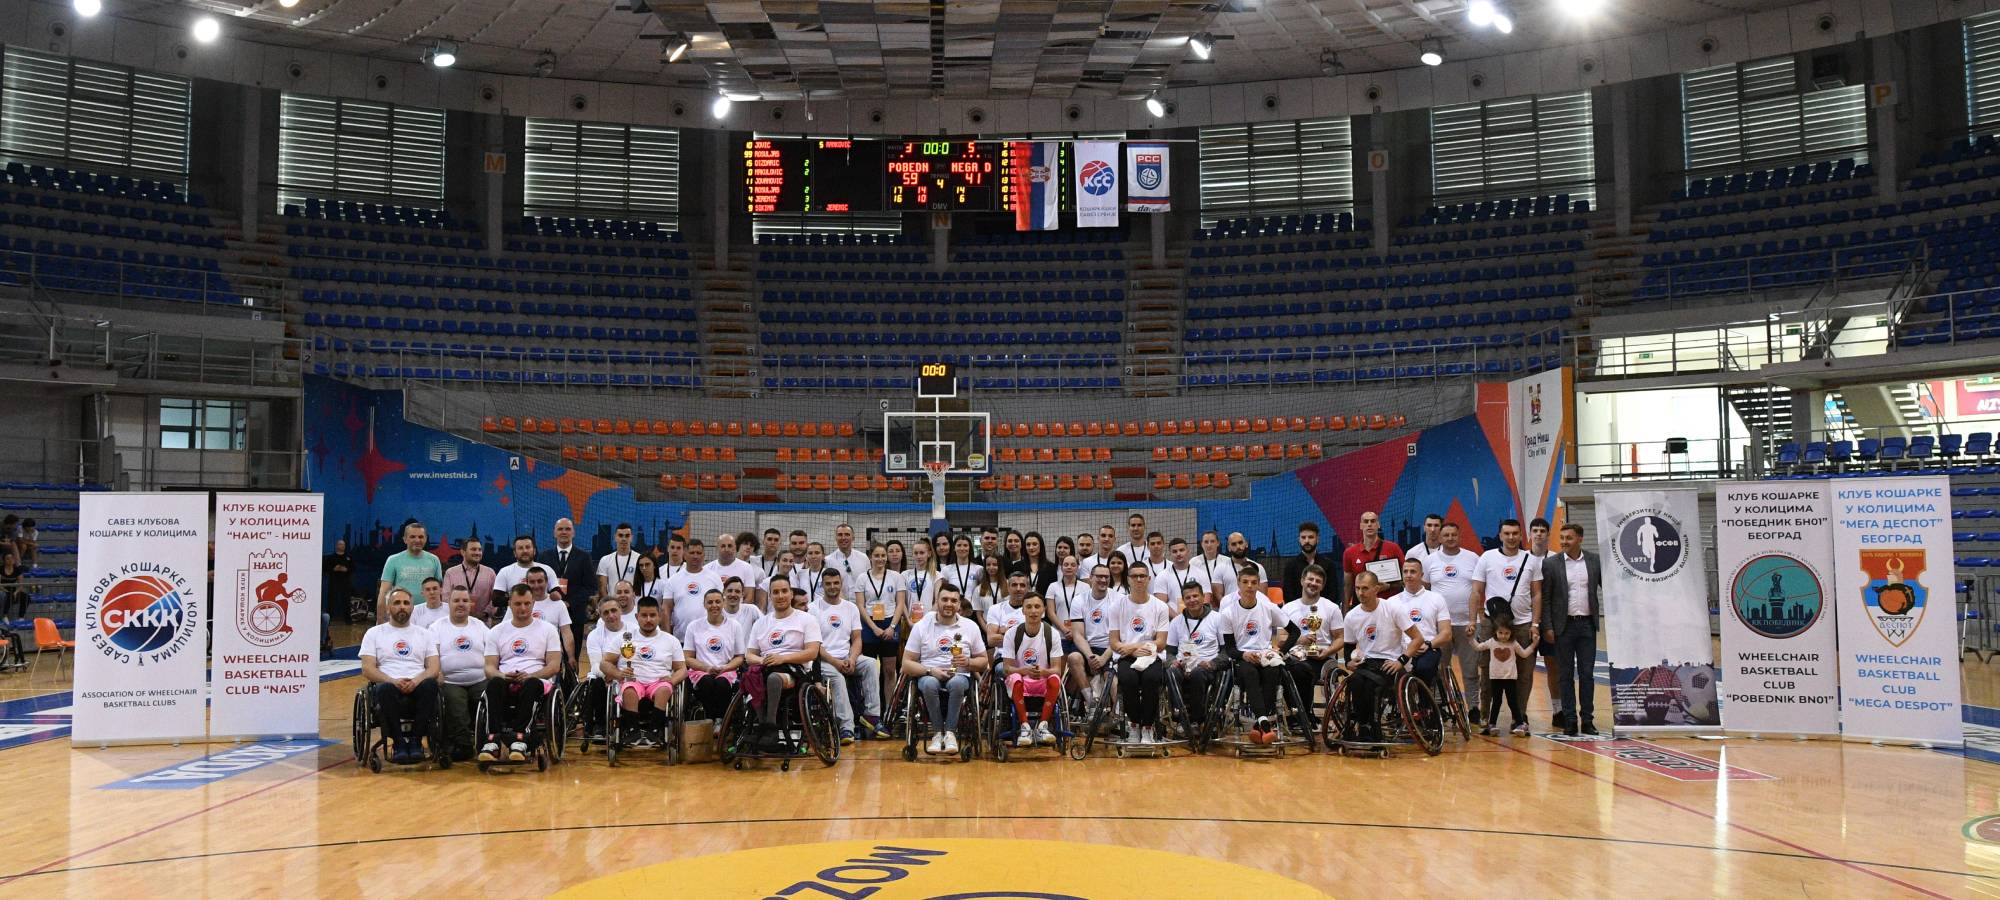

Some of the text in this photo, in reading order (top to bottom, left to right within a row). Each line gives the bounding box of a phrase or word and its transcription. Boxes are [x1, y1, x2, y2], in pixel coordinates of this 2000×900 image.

[1875, 84, 1892, 106] P
[906, 143, 912, 152] 3
[924, 142, 949, 154] 00:0
[968, 142, 974, 152] 5
[486, 154, 504, 171] M
[889, 162, 929, 172] POBEDN
[951, 163, 992, 172] MEGA D
[903, 173, 918, 184] 59
[965, 173, 980, 184] 41
[937, 179, 944, 189] 4
[923, 365, 946, 376] 00:0
[881, 401, 888, 409] C
[1538, 433, 1549, 443] Ниш
[409, 472, 477, 481] www.investnis.rs
[1728, 491, 1819, 501] КЛУБ КОШАРКЕ
[1838, 488, 1942, 499] КЛУБ КОШАРКЕ
[223, 504, 317, 512] КЛУБ КОШАРКЕ
[1735, 505, 1813, 514] У КОЛИЦИМА
[1846, 503, 1935, 514] У КОЛИЦИМА
[230, 518, 310, 527] У КОЛИЦИМА
[1722, 517, 1828, 528] “ПОБЕДНИК БН01”
[1840, 518, 1943, 530] “МЕГА ДЕСПОТ”
[144, 530, 197, 538] КОЛИЦИМА
[227, 531, 272, 540] “НАИС”
[282, 532, 311, 540] НИШ
[1748, 532, 1802, 542] БЕОГРАД
[1862, 534, 1922, 545] БЕОГРАД
[253, 562, 283, 570] НАИС
[86, 562, 197, 664] САВЕЗ КЛУБОВА КОШАРКЕ У КОЛИЦИМА
[104, 608, 180, 627] СККК
[246, 632, 285, 644] КОЛИЦИМА
[223, 654, 309, 664] WHEELCHAIR
[1738, 652, 1819, 662] WHEELCHAIR
[1855, 654, 1942, 666] WHEELCHAIR
[225, 670, 307, 679] BASKETBALL
[1741, 666, 1818, 676] BASKETBALL
[1858, 670, 1940, 681] BASKETBALL
[226, 684, 305, 695] CLUB “NAIS”
[1763, 681, 1795, 689] CLUB
[1882, 685, 1916, 695] CLUB
[82, 690, 134, 698] ASSOCIATION
[1727, 694, 1796, 704] “POBEDNIK
[104, 700, 150, 708] BASKETBALL
[1849, 699, 1953, 712] “MEGA DESPOT”
